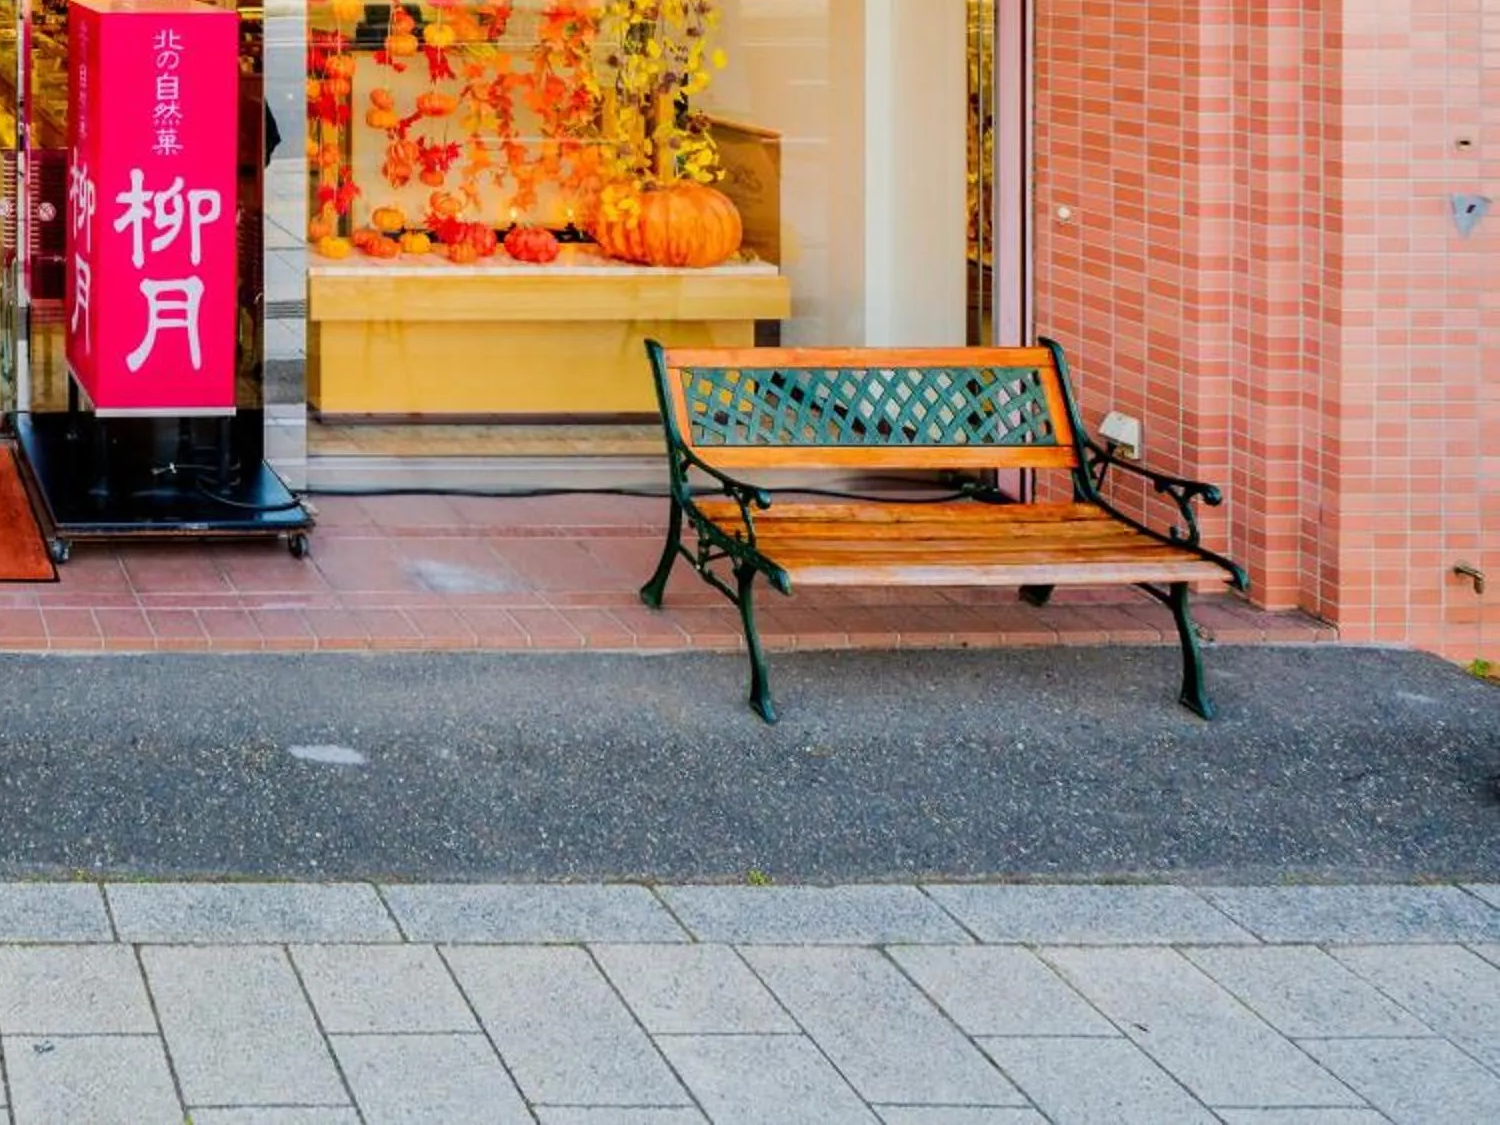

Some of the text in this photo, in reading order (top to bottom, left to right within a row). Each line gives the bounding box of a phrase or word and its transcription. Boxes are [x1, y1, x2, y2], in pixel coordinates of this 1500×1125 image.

[151, 27, 185, 156] 北の自然菓
[68, 146, 98, 356] 柳月
[113, 167, 222, 374] 柳月
